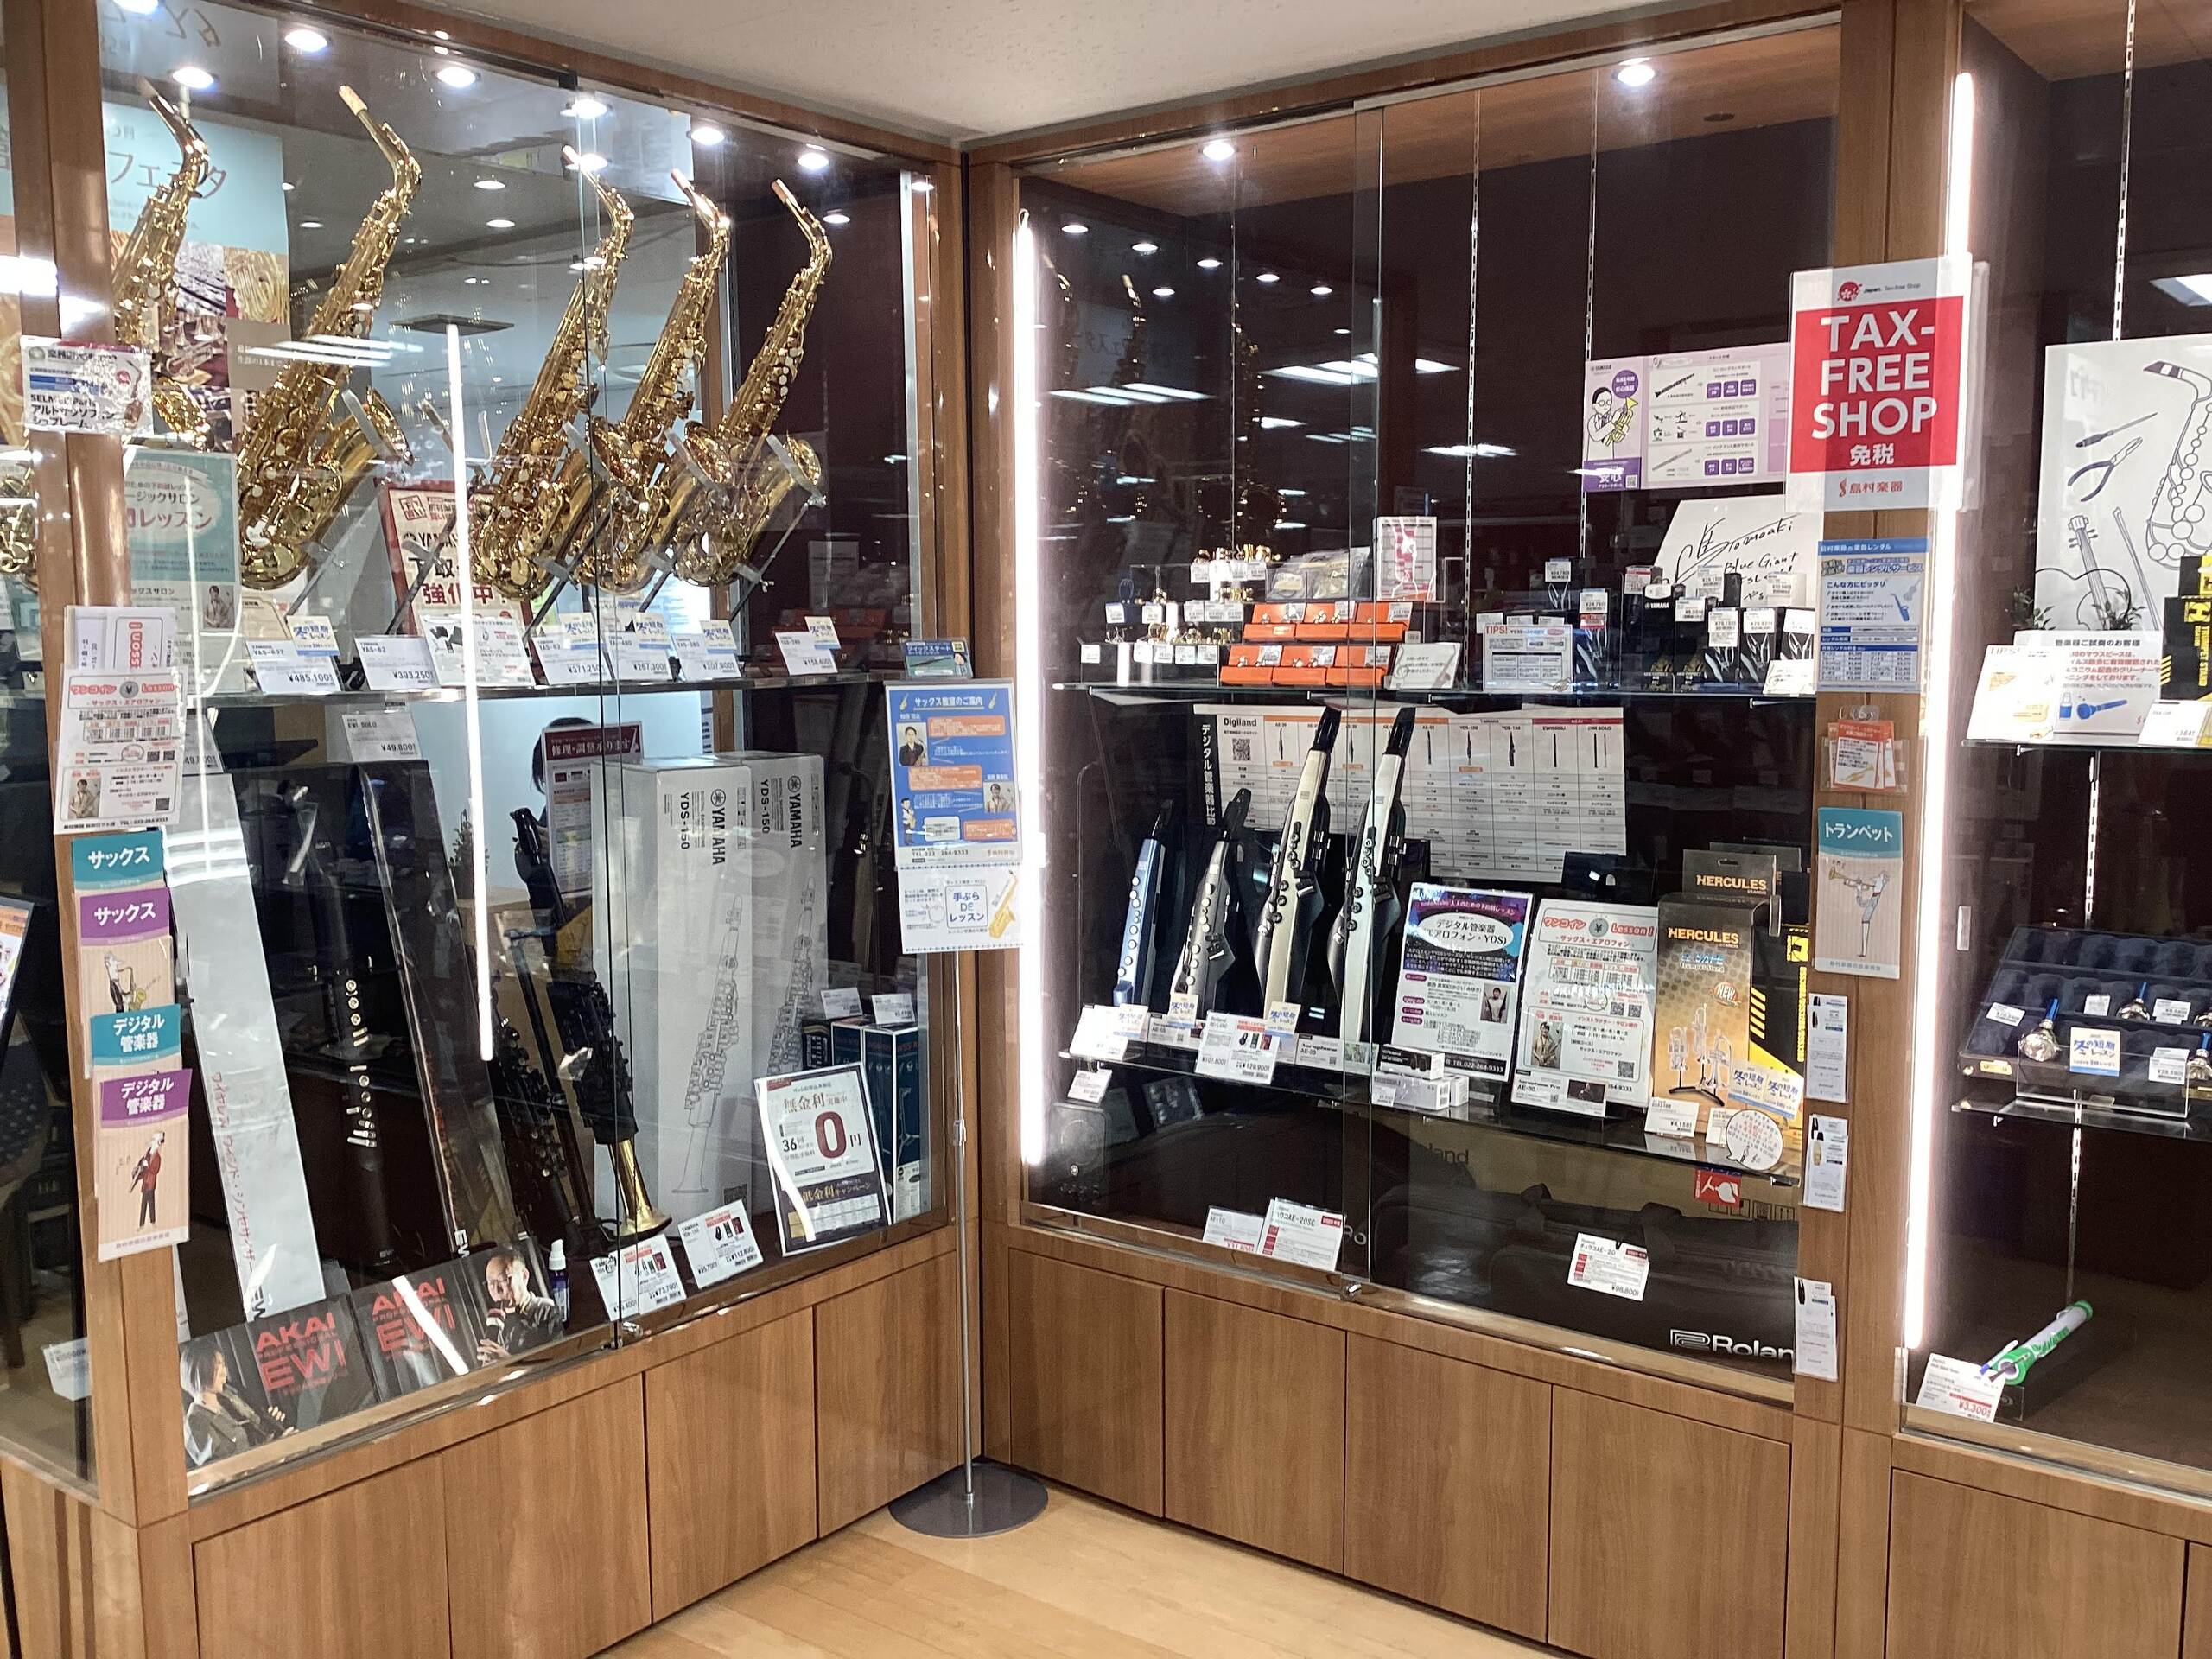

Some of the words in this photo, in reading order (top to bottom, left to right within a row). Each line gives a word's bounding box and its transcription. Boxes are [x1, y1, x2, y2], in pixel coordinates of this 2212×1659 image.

[1821, 308, 1936, 353] TAX-
[1821, 352, 1930, 397] FREE
[1812, 396, 1937, 440] SHOP
[1850, 443, 1895, 467] 免税
[1725, 558, 1752, 574] Blue
[1827, 580, 1885, 588] こんな方にピッタリ
[1485, 625, 1508, 635] TIPS!
[1223, 717, 1257, 728] Digiland
[760, 779, 771, 835] YDS-150
[679, 791, 690, 850] YDS-150
[787, 791, 802, 849] YAMAHA
[1825, 821, 1894, 843] トランペット
[88, 846, 151, 870] サックス
[1696, 874, 1767, 892] HERCULES
[953, 892, 980, 901] 手ぶら
[960, 903, 974, 912] DE
[93, 901, 156, 927] サックス
[950, 912, 984, 923] レッスン
[1436, 918, 1496, 934] デジタル管楽器
[1543, 916, 1586, 931] ワンコイン
[1611, 922, 1655, 937] Lesson!
[1668, 926, 1739, 945] HERCULES
[1560, 935, 1630, 949] サックス・エアロフォン
[1716, 983, 1736, 1001] NEW
[113, 1014, 165, 1036] デジタル
[120, 1031, 159, 1053] 管楽器
[2091, 1049, 2116, 1058] レッスン
[121, 1077, 175, 1099] デジタル
[126, 1093, 166, 1116] 管楽器
[257, 1312, 336, 1353] AKAI
[1712, 1334, 1794, 1360] Rolan
[261, 1339, 346, 1392] EWI
[1959, 1400, 1988, 1416] ¥3,300
